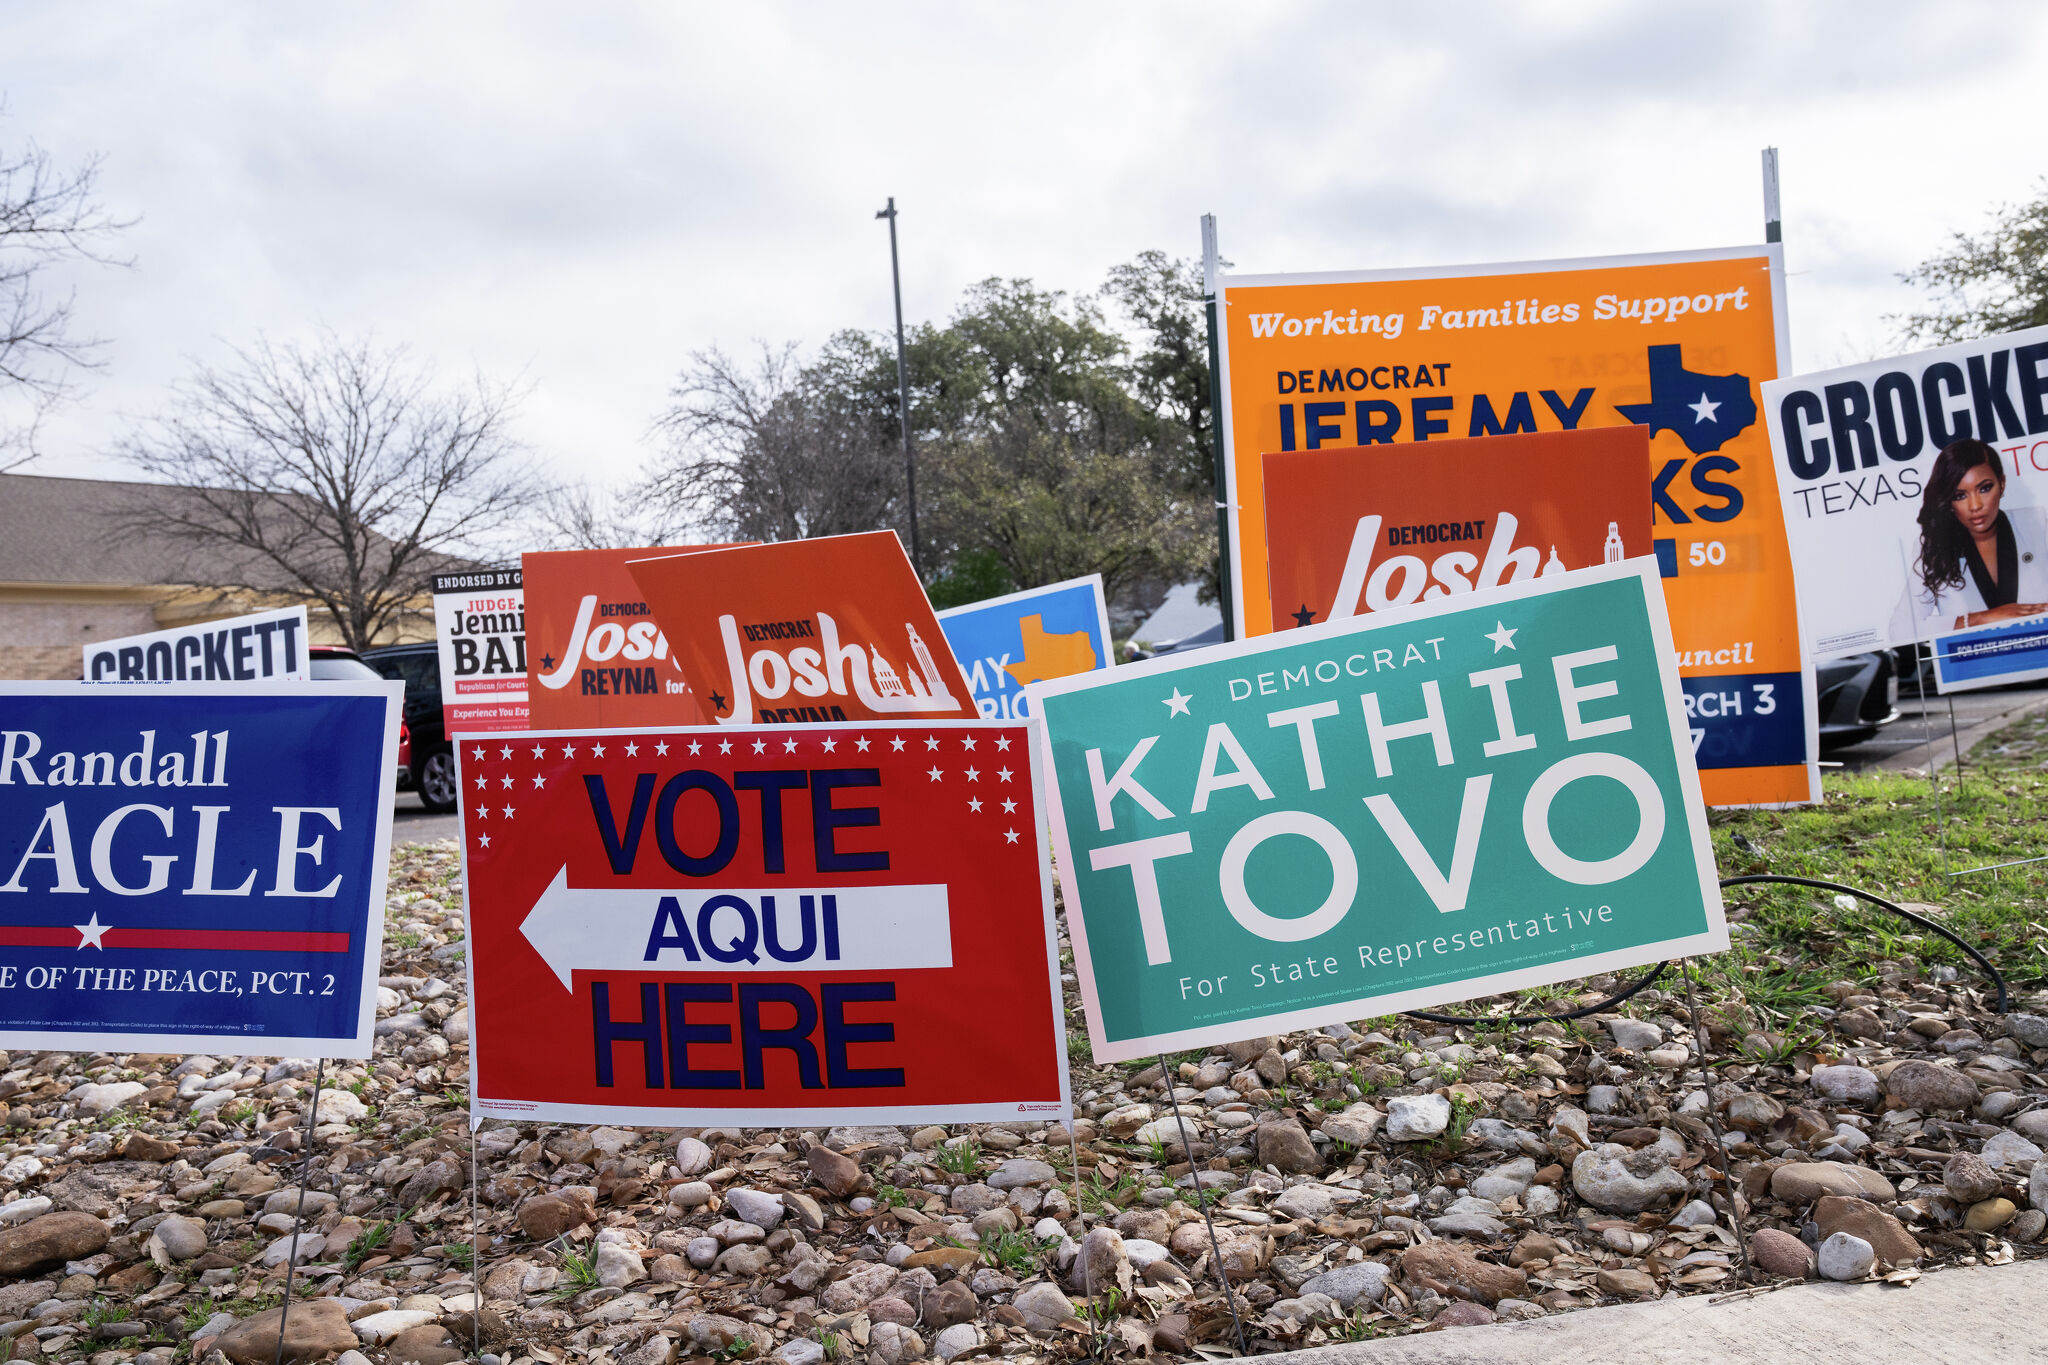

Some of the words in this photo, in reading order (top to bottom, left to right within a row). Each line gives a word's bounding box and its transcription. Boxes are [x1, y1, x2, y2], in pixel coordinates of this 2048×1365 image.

[1248, 309, 1404, 340] Working
[1418, 297, 1581, 331] Families
[1593, 286, 1749, 325] Support
[1277, 363, 1452, 394] DEMOCRAT
[1651, 455, 1745, 526] KS
[1793, 468, 1922, 518] TEXAS
[2002, 440, 2048, 477] TO
[1388, 520, 1486, 547] DEMOCRAT
[1325, 511, 1542, 622] Josh
[1689, 541, 1727, 567] 50
[437, 574, 494, 589] ENDORSED
[497, 573, 512, 585] BY
[513, 573, 523, 584] G
[451, 603, 525, 636] Jenni
[467, 598, 516, 613] JUDGE
[601, 602, 652, 617] DEMOCR
[743, 619, 815, 642] DEMOCRAT
[714, 611, 882, 724] Josh
[1228, 637, 1447, 702] DEMOCRAT
[1675, 643, 1755, 667] uncil
[459, 680, 495, 692] Republican
[496, 680, 506, 692] for
[506, 680, 526, 690] Court
[581, 667, 659, 696] REYNA
[665, 679, 685, 694] for
[960, 653, 1010, 695] MY
[453, 708, 497, 721] Experience
[498, 707, 514, 718] You
[515, 706, 530, 719] Exp
[977, 689, 1030, 719] RIC
[1683, 691, 1743, 719] RCH
[1752, 684, 1777, 715] 3
[1084, 643, 1633, 832] KATHIE
[1690, 727, 1706, 757] 7
[0, 730, 229, 787] Randall
[582, 767, 891, 876] VOTE
[0, 800, 343, 898] AGLE
[1088, 751, 1666, 965] TOVO
[643, 894, 841, 966] AQUI
[1179, 973, 1230, 1000] For
[1250, 953, 1339, 988] State
[1358, 902, 1615, 970] Representative
[0, 965, 18, 989] E
[25, 966, 67, 990] OF
[73, 966, 136, 991] THE
[141, 969, 244, 998] PEACE,
[250, 971, 315, 996] PCT.
[321, 973, 336, 996] 2
[591, 981, 907, 1090] HERE
